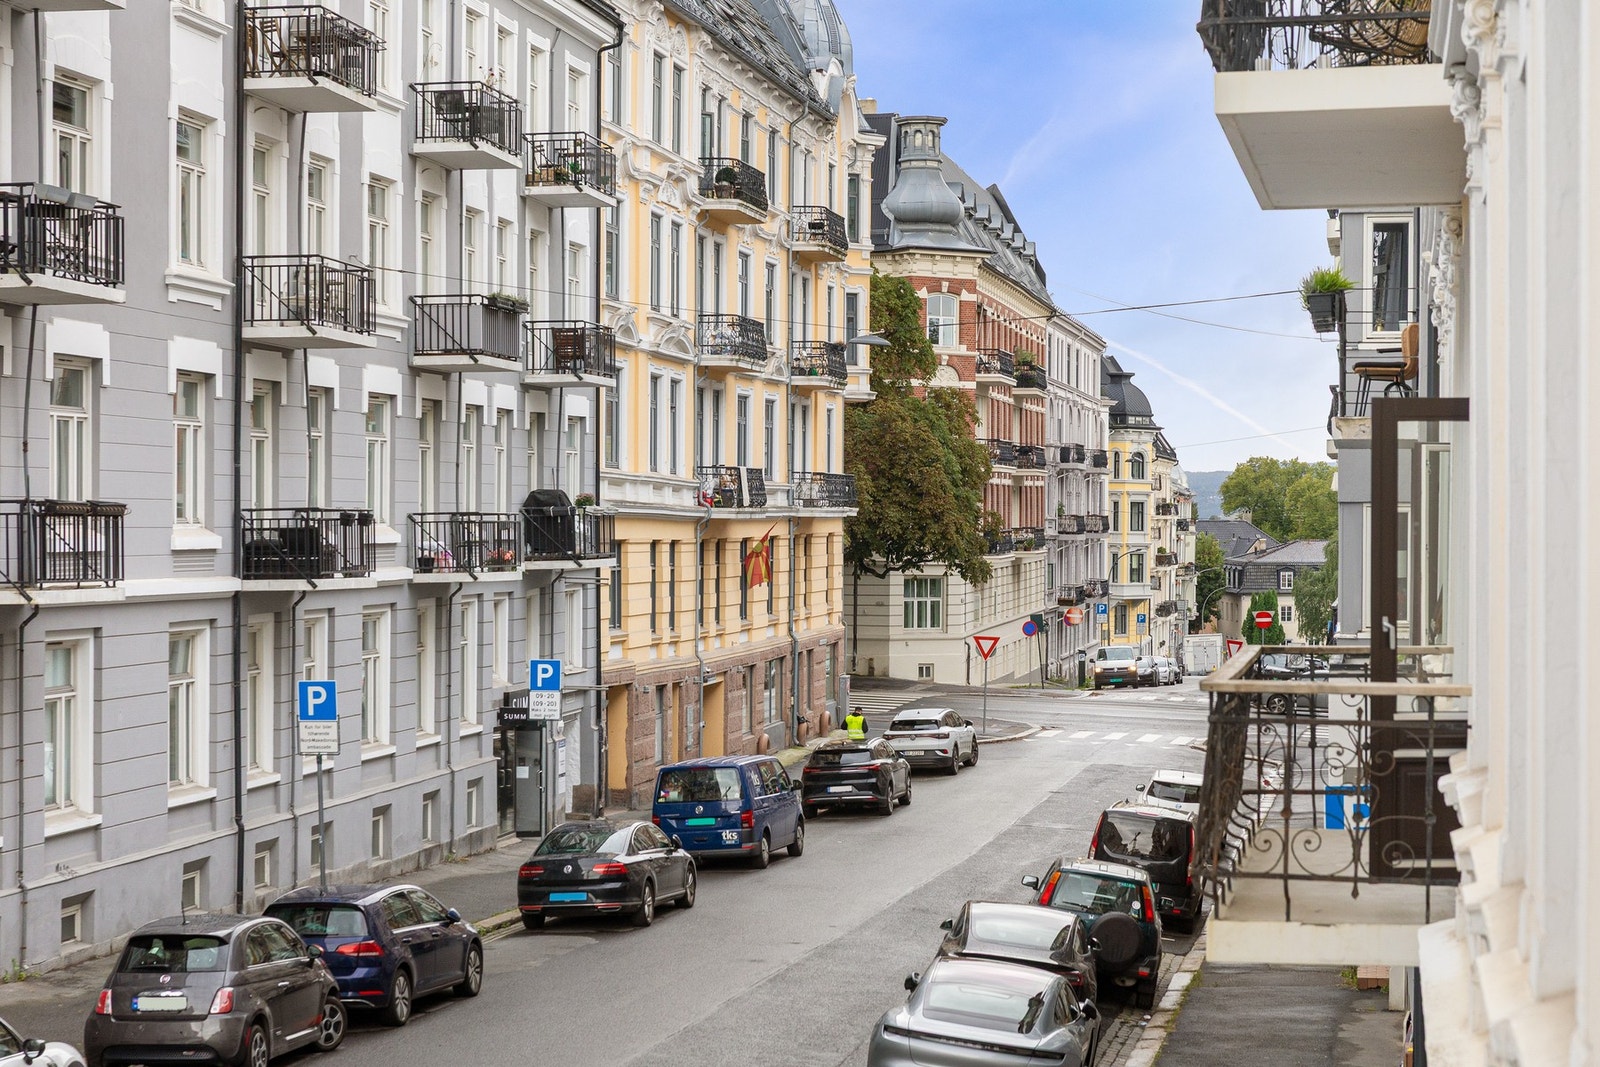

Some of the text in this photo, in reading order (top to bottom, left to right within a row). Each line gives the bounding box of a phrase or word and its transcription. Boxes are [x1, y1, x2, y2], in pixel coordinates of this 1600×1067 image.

[1099, 605, 1105, 613] P
[537, 664, 553, 687] P
[307, 686, 327, 716] P
[721, 830, 738, 840] tks
